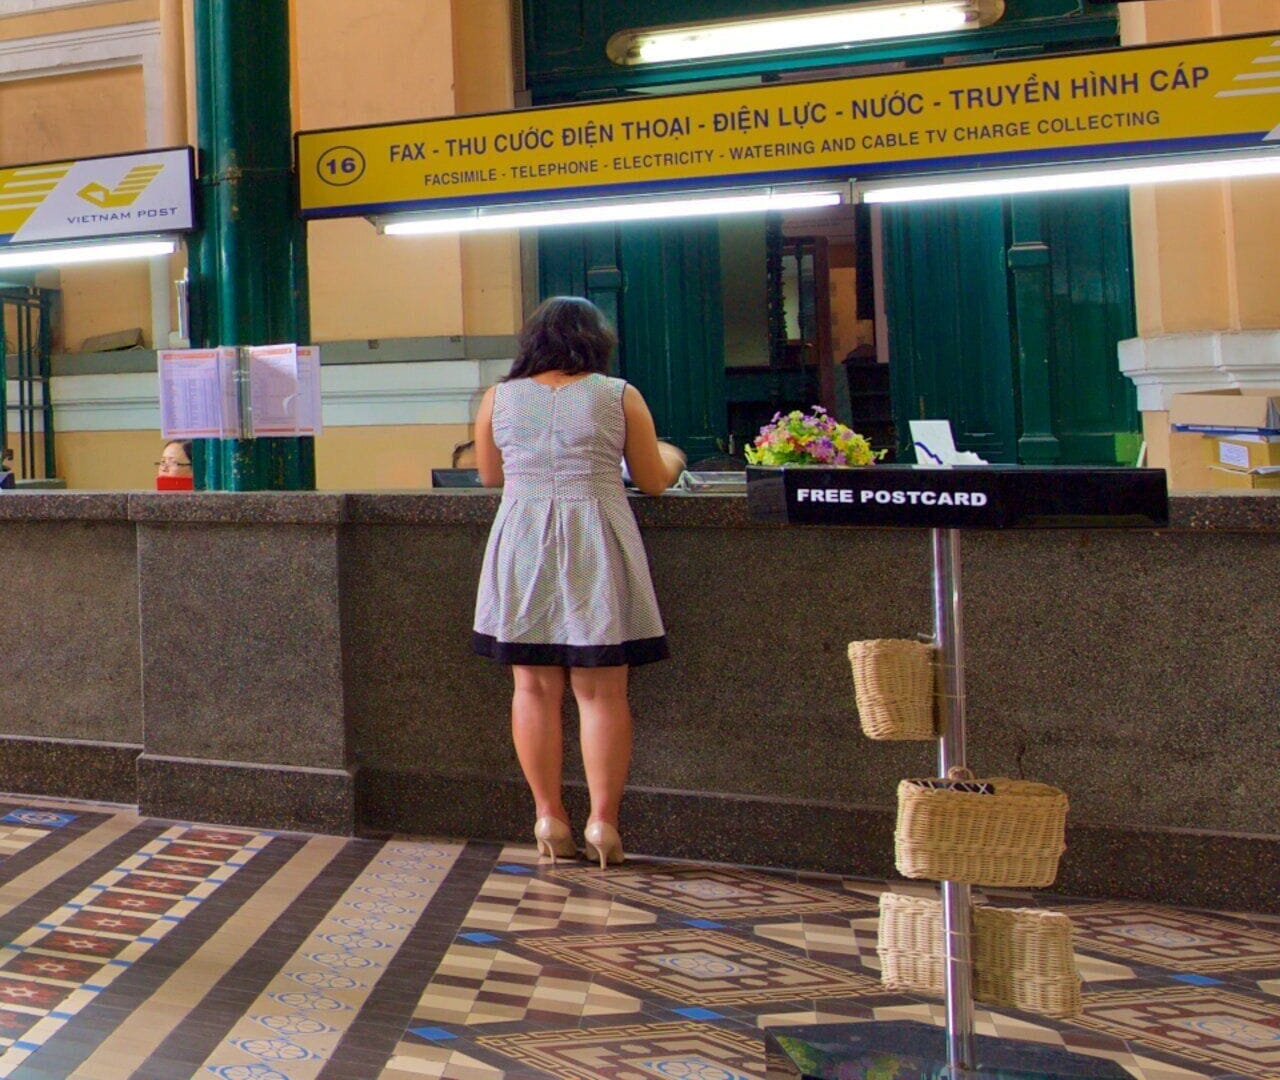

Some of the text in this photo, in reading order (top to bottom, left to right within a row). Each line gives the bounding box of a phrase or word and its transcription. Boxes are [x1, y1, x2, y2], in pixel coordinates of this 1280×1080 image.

[389, 143, 426, 163] FAX
[445, 136, 487, 157] THU
[494, 126, 555, 155] CƯỚC
[561, 120, 615, 147] ĐIỆN
[622, 116, 690, 143] THOẠI
[714, 104, 770, 134] ĐIỆN
[778, 103, 827, 130] LỰC
[851, 92, 923, 122] NƯỚC
[949, 73, 1060, 112] TRUYỀN
[1071, 67, 1139, 100] HÌNH
[1150, 61, 1210, 93] CÁP
[424, 168, 497, 187] FACSIMILE
[510, 158, 599, 180] TELEPHONE
[613, 149, 714, 172] ELECTRICITY
[730, 137, 818, 162] WATERING
[820, 136, 856, 152] AND
[861, 130, 920, 148] CABLE
[925, 128, 947, 143] TV
[954, 120, 1031, 142] CHARGE
[1038, 110, 1161, 135] COLLECTING
[326, 157, 356, 175] 16
[66, 206, 177, 224] VIETNAM POST
[797, 488, 987, 507] FREE POSTCARD
